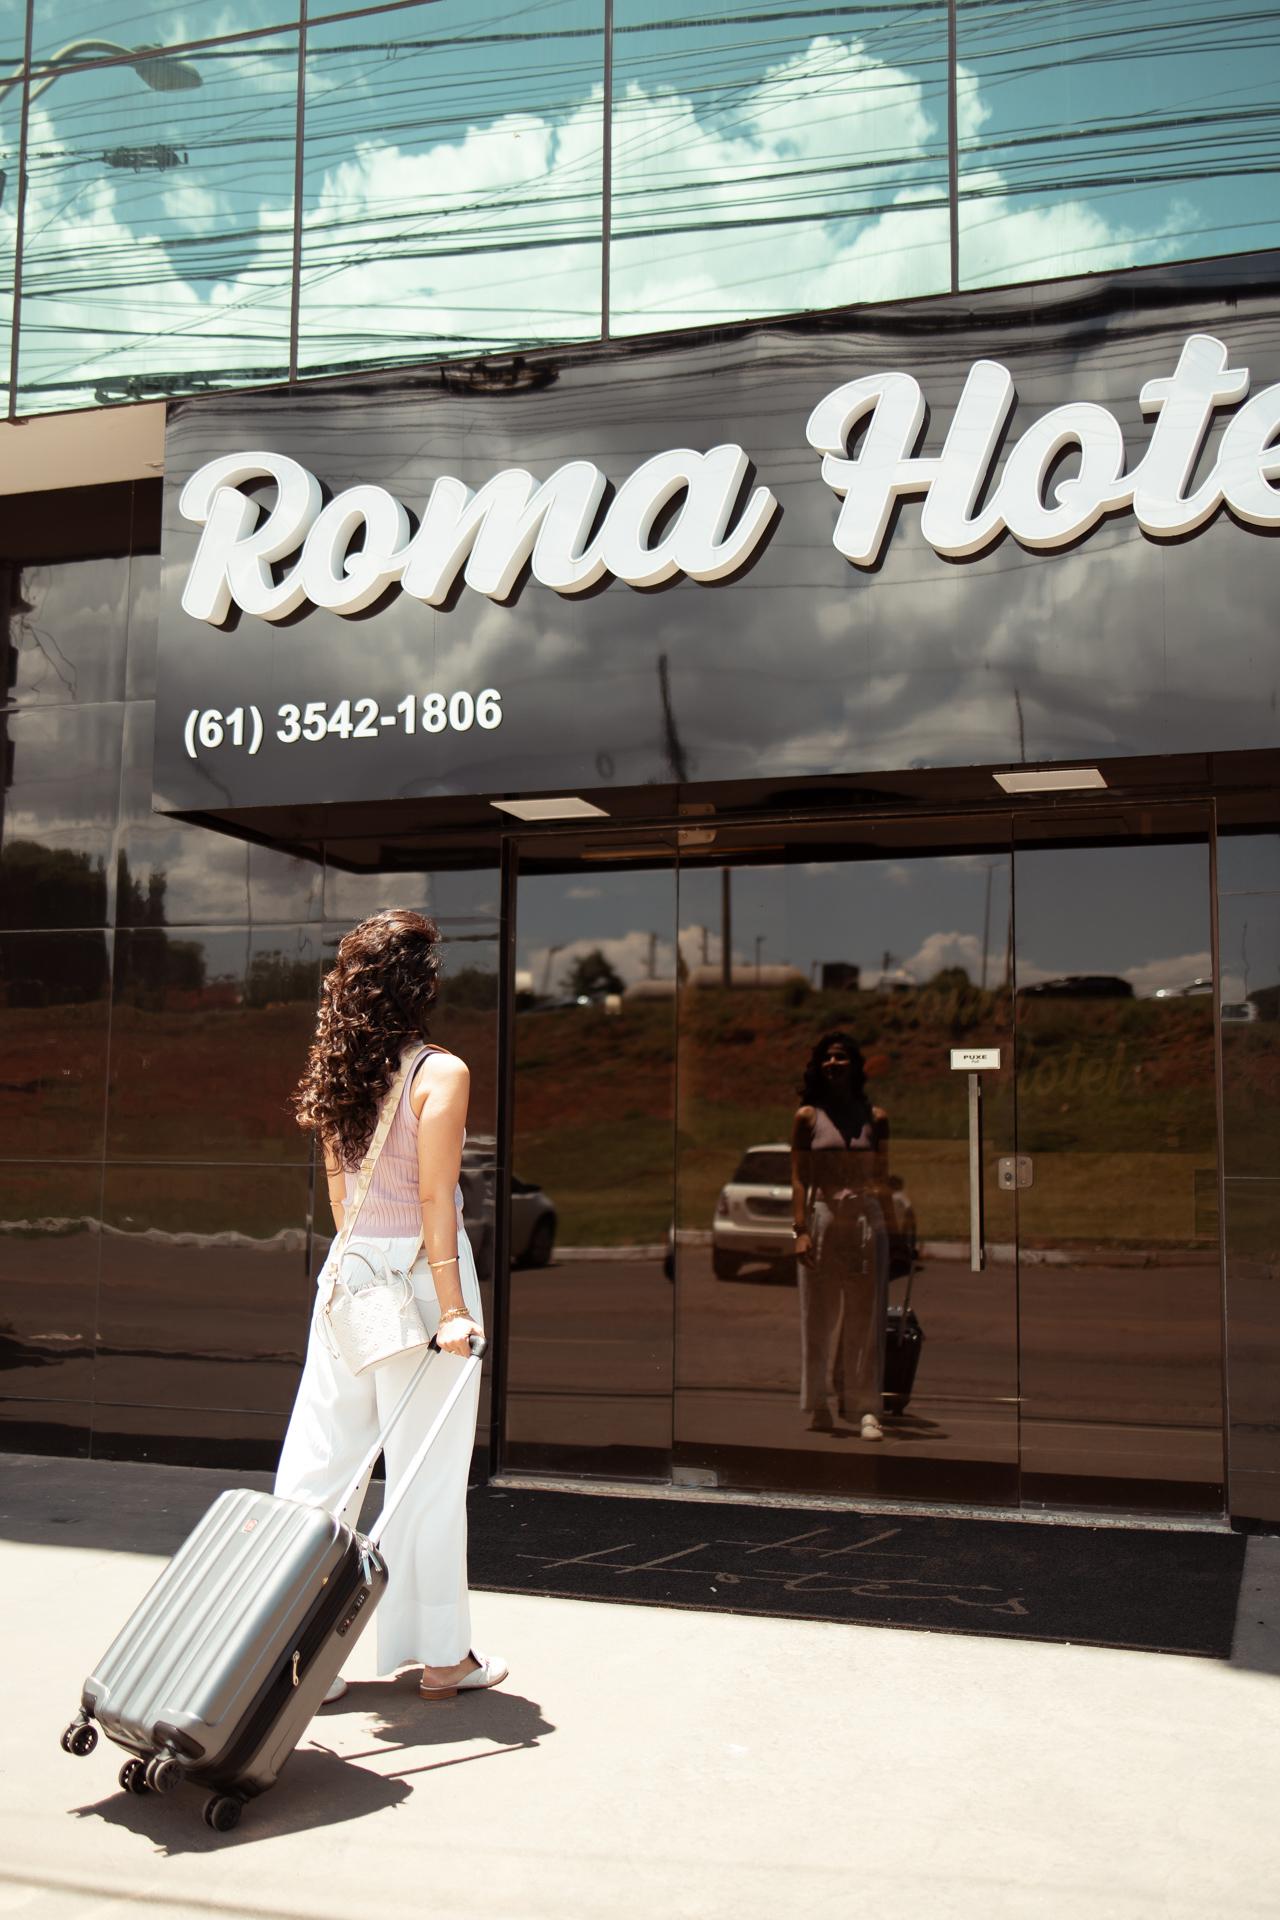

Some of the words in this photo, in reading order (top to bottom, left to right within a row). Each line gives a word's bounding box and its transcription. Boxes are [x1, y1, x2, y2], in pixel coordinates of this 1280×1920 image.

[180, 444, 778, 626] Roma
[184, 706, 264, 759] (61)
[276, 688, 503, 743] 3542-1806
